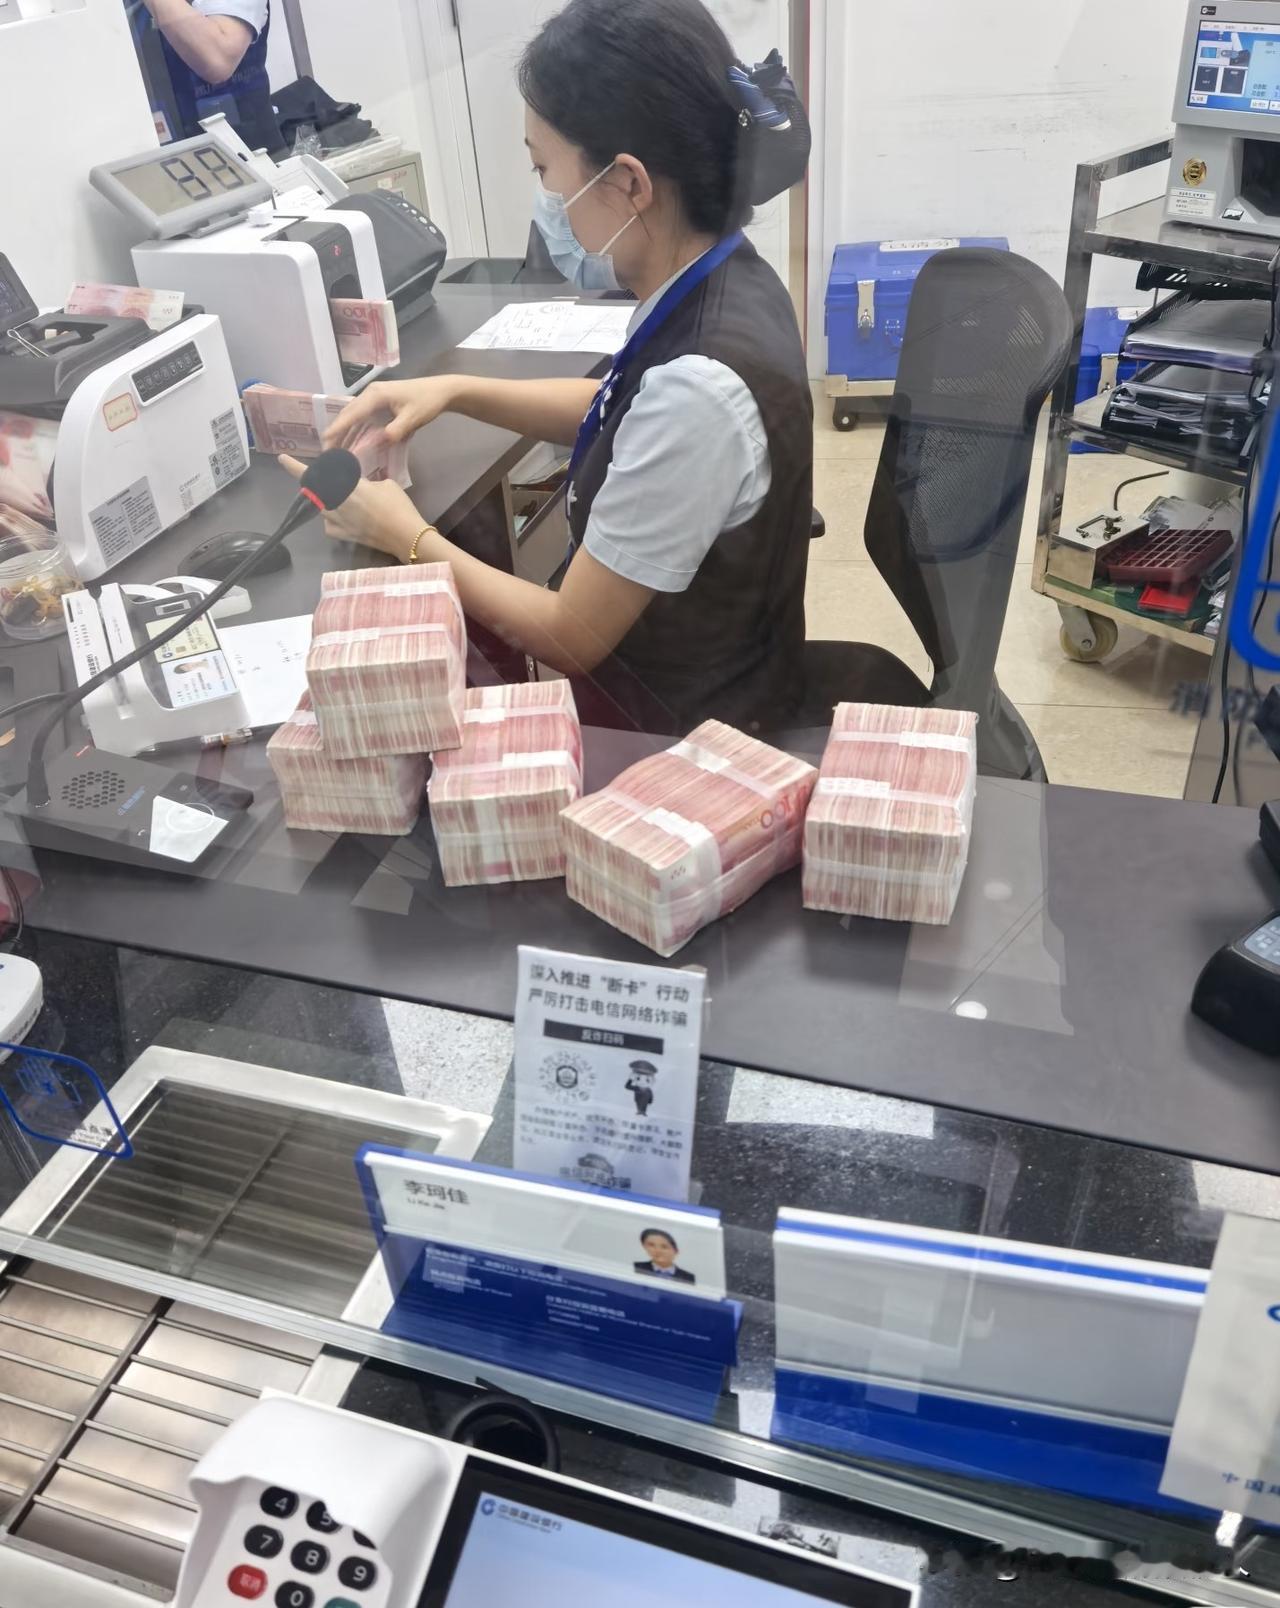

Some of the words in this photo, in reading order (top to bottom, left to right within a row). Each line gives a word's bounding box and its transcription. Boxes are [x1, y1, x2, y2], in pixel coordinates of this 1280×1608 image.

[528, 988, 688, 1027] 严厉打击电信网络诈骗
[275, 1497, 289, 1511] 4
[259, 1534, 274, 1550] 7
[305, 1550, 320, 1566] 8
[353, 1566, 368, 1581] 9
[290, 1590, 304, 1607] 0
